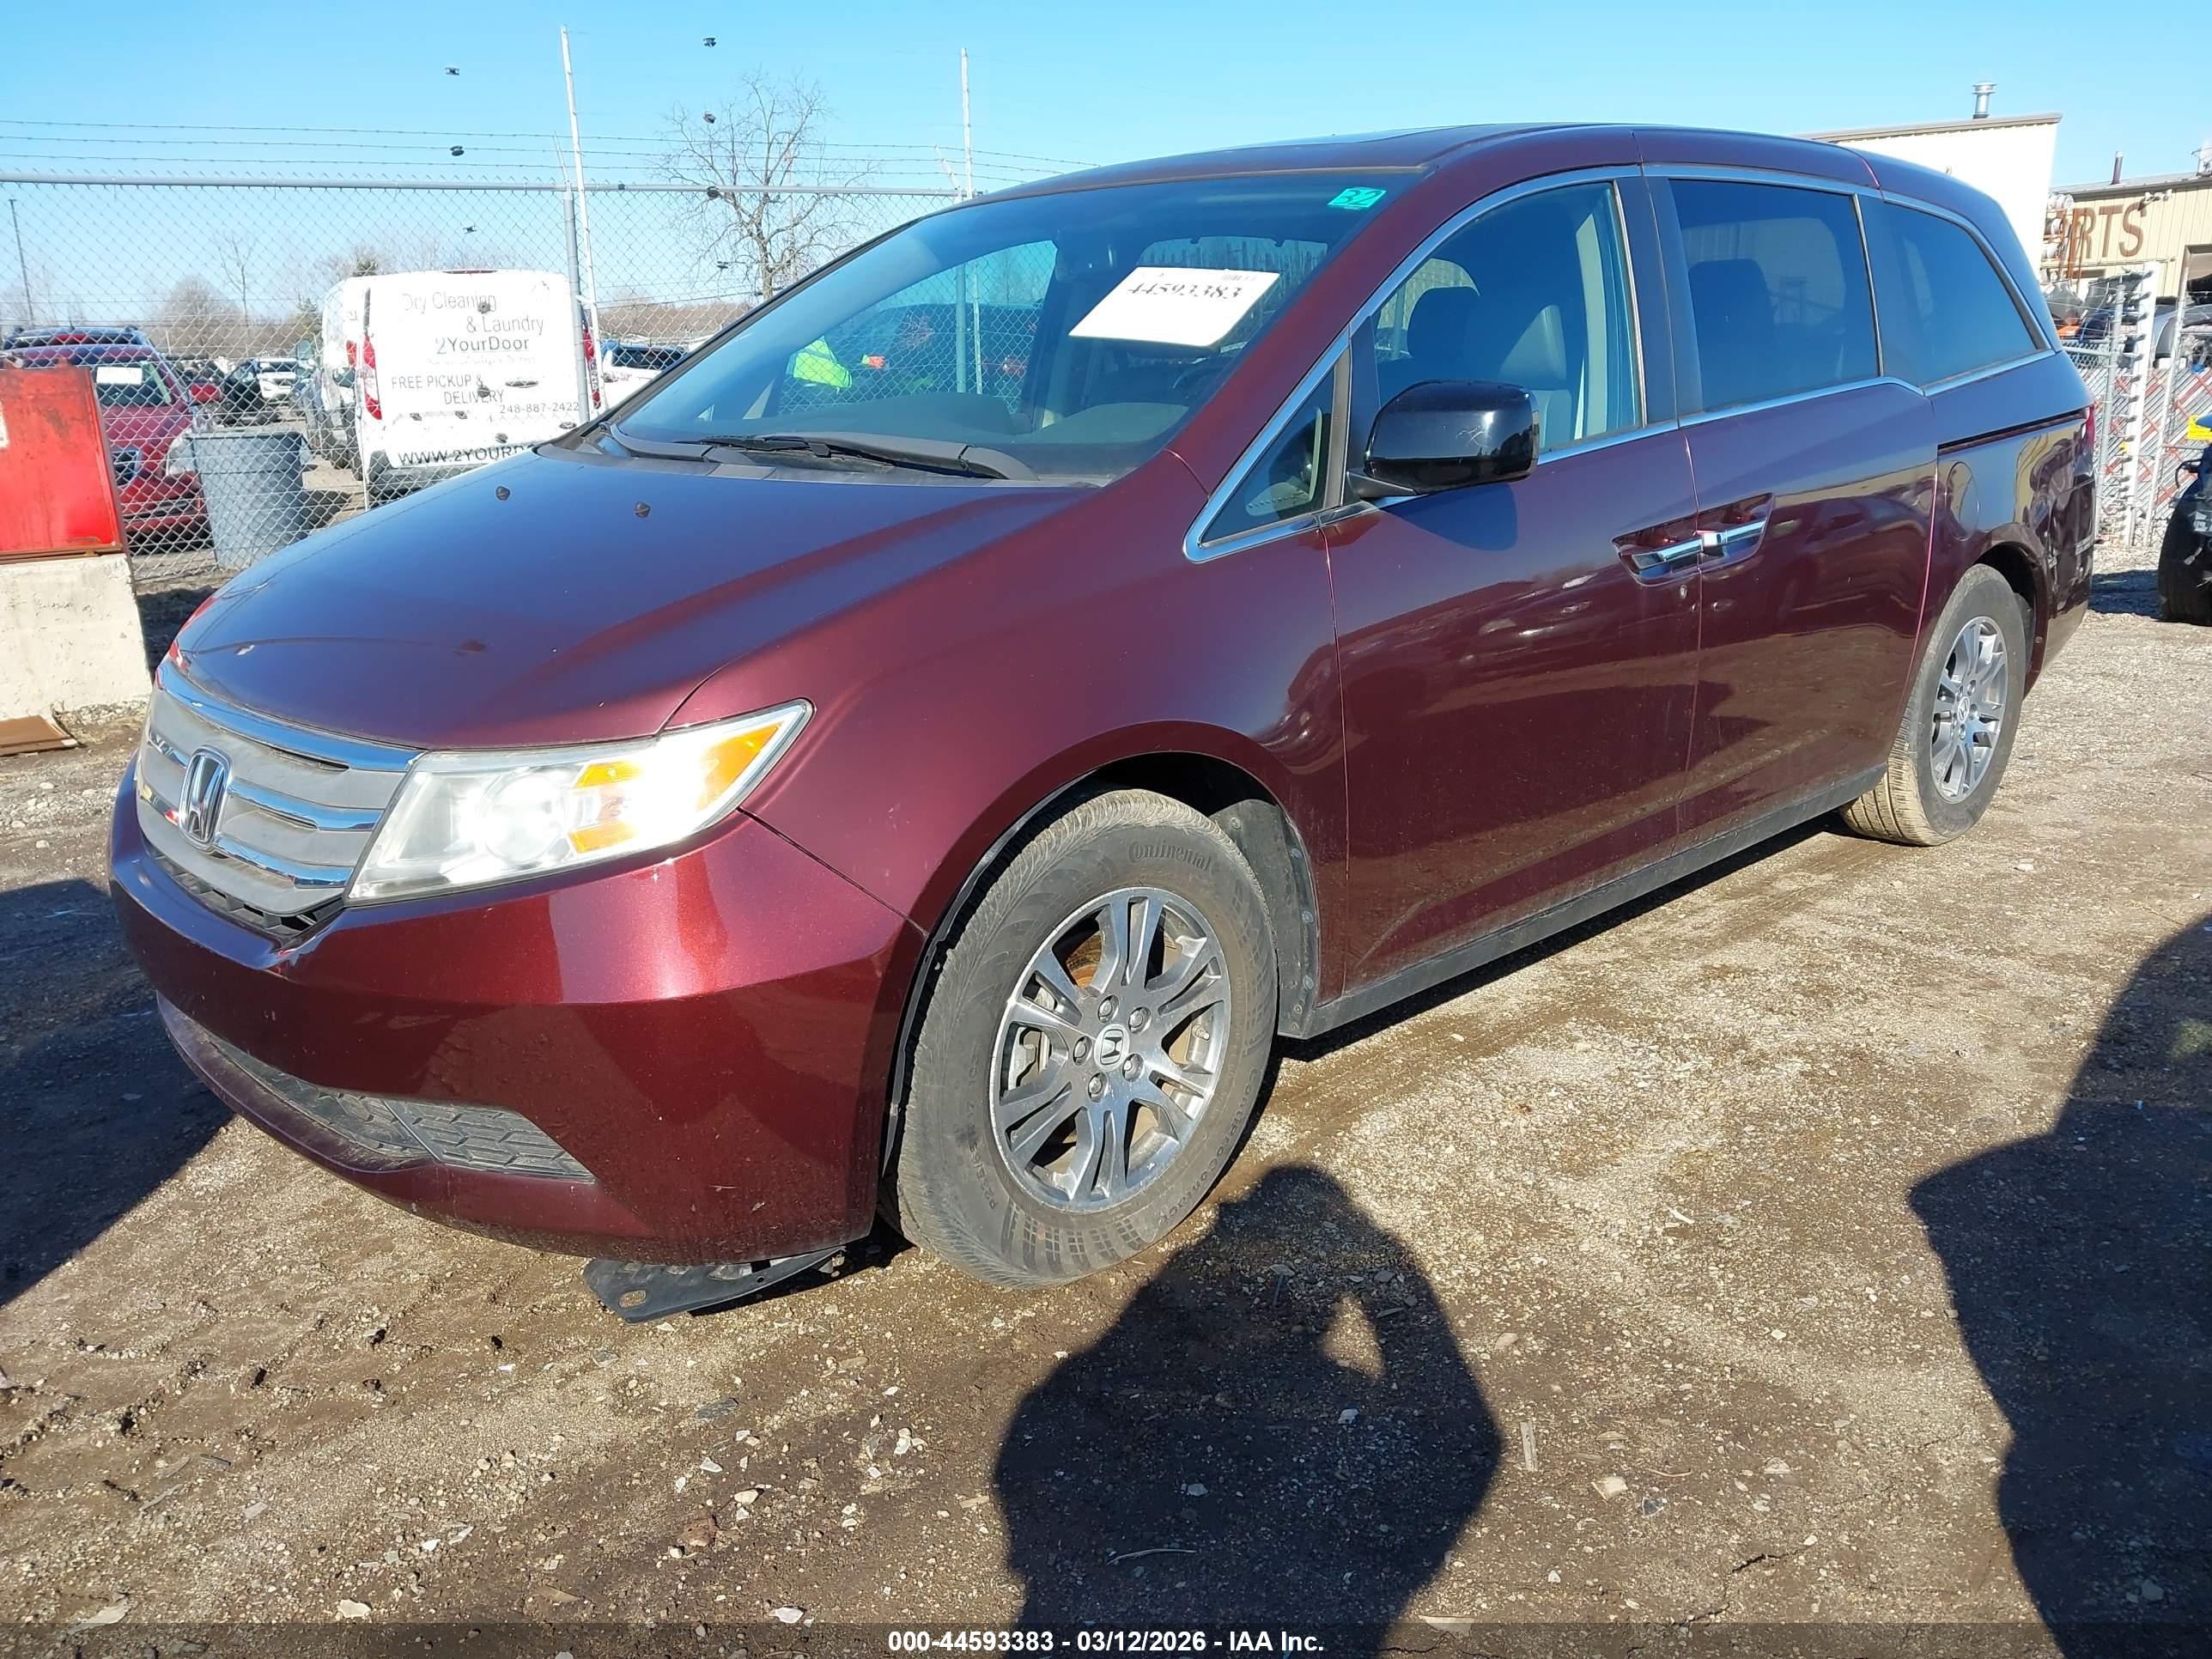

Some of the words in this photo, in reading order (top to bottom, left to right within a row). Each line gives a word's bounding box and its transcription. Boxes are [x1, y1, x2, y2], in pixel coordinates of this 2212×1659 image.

[1127, 282, 1244, 301] 44593383
[402, 292, 427, 314] Dry
[432, 290, 497, 313] Cleaning
[466, 315, 477, 333] &
[482, 314, 544, 336] Laundry
[435, 336, 530, 355] 2YourDoor
[392, 375, 423, 389] FREE
[427, 374, 472, 389] PICKUP
[444, 389, 505, 405] DELIVERY
[499, 402, 580, 415] 248-887-2422
[398, 443, 534, 465] WWW.2YOURD
